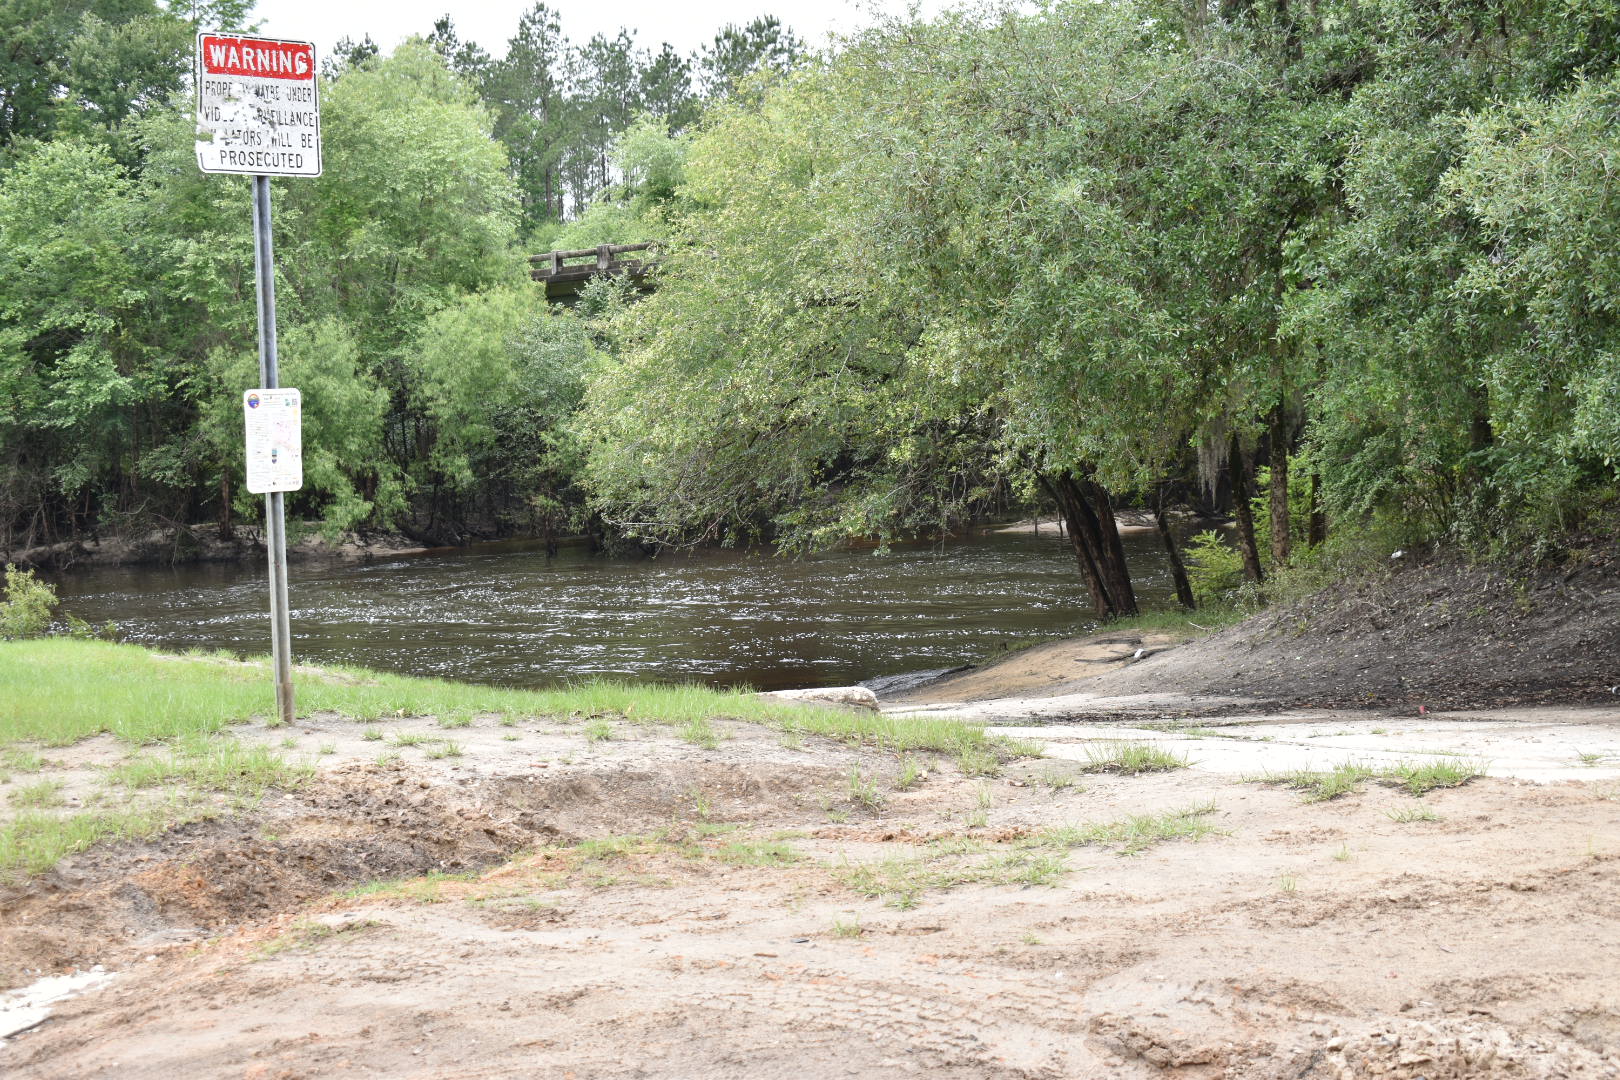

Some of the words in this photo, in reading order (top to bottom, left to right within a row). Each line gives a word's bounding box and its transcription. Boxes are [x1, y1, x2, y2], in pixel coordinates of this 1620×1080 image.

[209, 44, 309, 75] WARNING
[286, 86, 312, 103] UNDER
[204, 105, 235, 122] VID
[271, 132, 292, 148] WILL
[301, 133, 313, 149] BE
[220, 150, 303, 168] PROSECUTED
